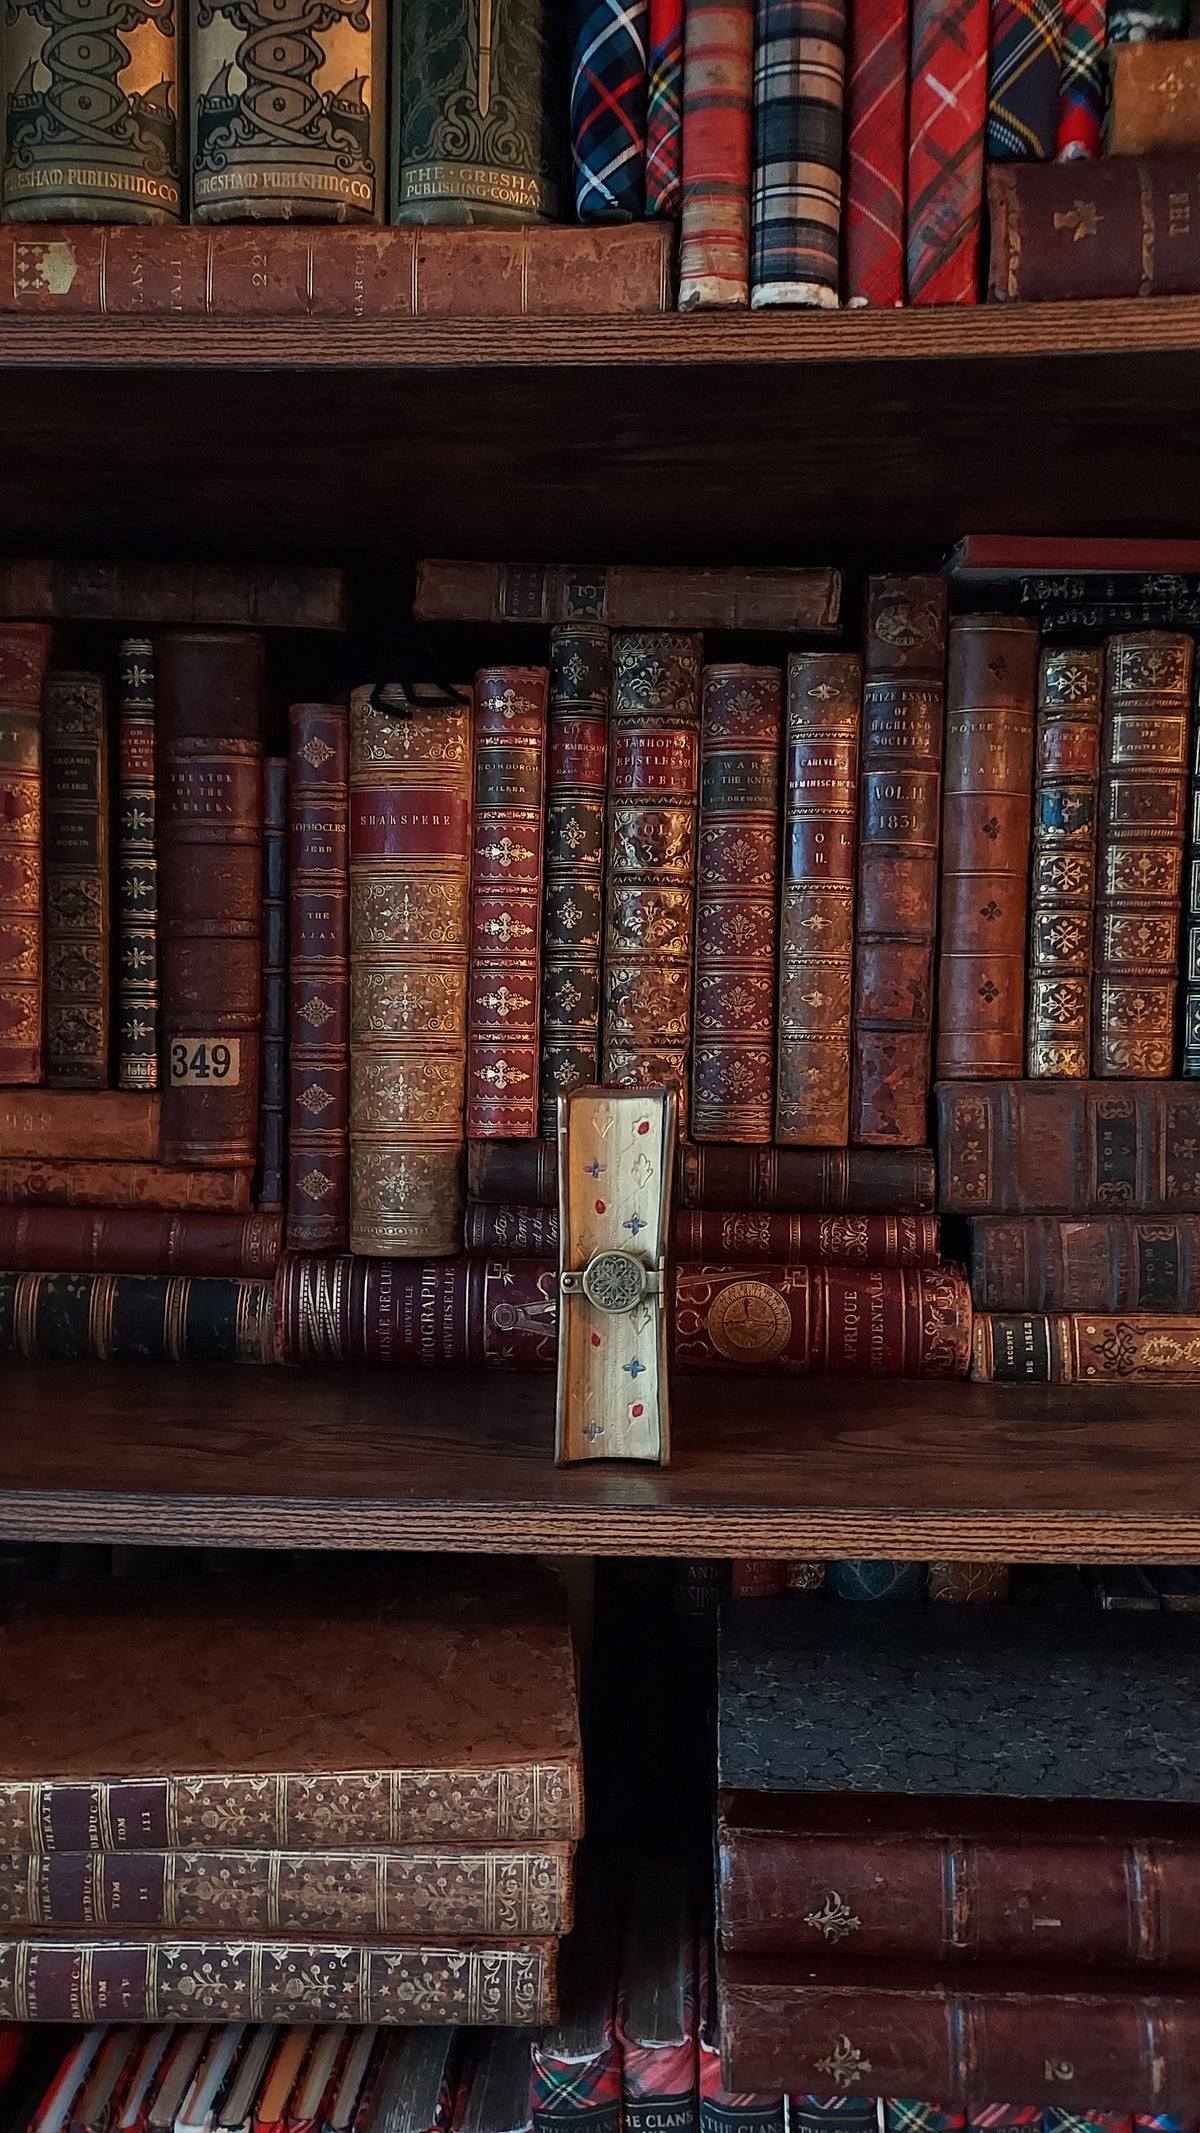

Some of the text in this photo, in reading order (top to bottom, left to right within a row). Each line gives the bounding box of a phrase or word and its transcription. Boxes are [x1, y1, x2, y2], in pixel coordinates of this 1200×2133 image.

[68, 169, 156, 195] PUBLISHING
[263, 171, 349, 193] PUBLISHING
[405, 166, 540, 193] THE GRESHA
[490, 186, 543, 207] COMPAN
[252, 254, 267, 287] 22
[865, 690, 940, 704] PRIZE ESSAYS
[894, 706, 908, 717] OF
[723, 761, 760, 770] WAR
[170, 773, 233, 783] THEATRE
[615, 775, 688, 788] GOSPELS
[721, 776, 742, 785] THE
[199, 787, 224, 797] THE
[290, 823, 346, 833] SOPHOCLES
[359, 814, 451, 826] SHAKSPERE
[306, 911, 330, 920] THE
[300, 931, 338, 941] AJAX
[171, 1043, 232, 1079] 349
[1104, 1131, 1114, 1171] TOM
[404, 1285, 414, 1344] NOUVELLE
[443, 1267, 455, 1358] UNIVERSELLE
[844, 1290, 861, 1362] AFRIQUE
[1005, 1329, 1014, 1366] LECONTE
[1024, 1321, 1034, 1374] DE LISLE
[42, 1789, 55, 1851] THEATR
[117, 1817, 126, 1842] TOM
[141, 1810, 151, 1832] III
[111, 1880, 120, 1909] TOM
[98, 1979, 108, 2009] TOM
[1044, 2058, 1075, 2081] 2
[645, 2110, 694, 2129] CLANS
